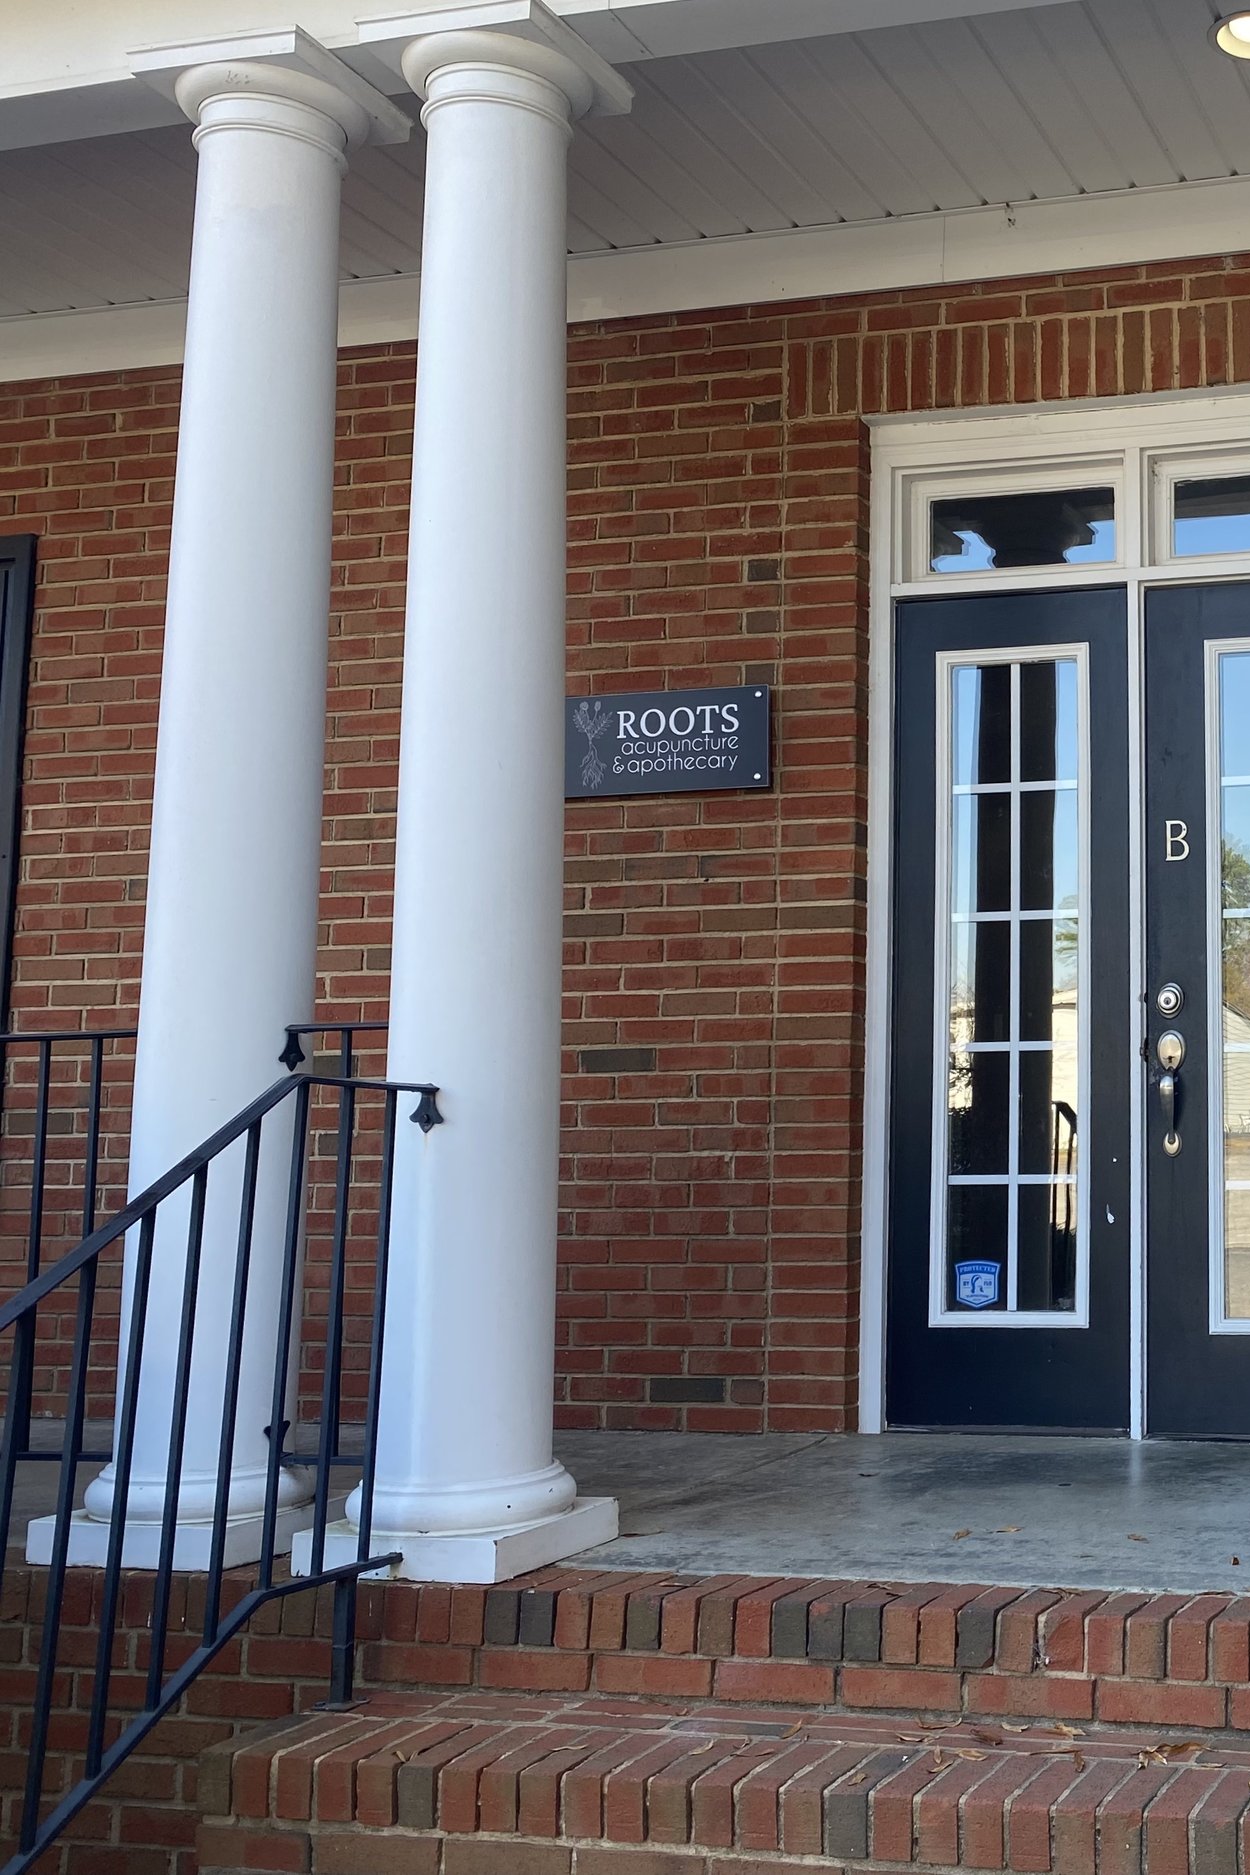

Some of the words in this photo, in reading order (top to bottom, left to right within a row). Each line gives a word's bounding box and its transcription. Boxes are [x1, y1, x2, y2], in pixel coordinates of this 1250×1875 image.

[616, 703, 740, 739] ROOTS
[621, 735, 739, 757] acupuncture
[612, 756, 625, 774] &
[627, 753, 738, 776] apothecary
[1165, 820, 1190, 861] B
